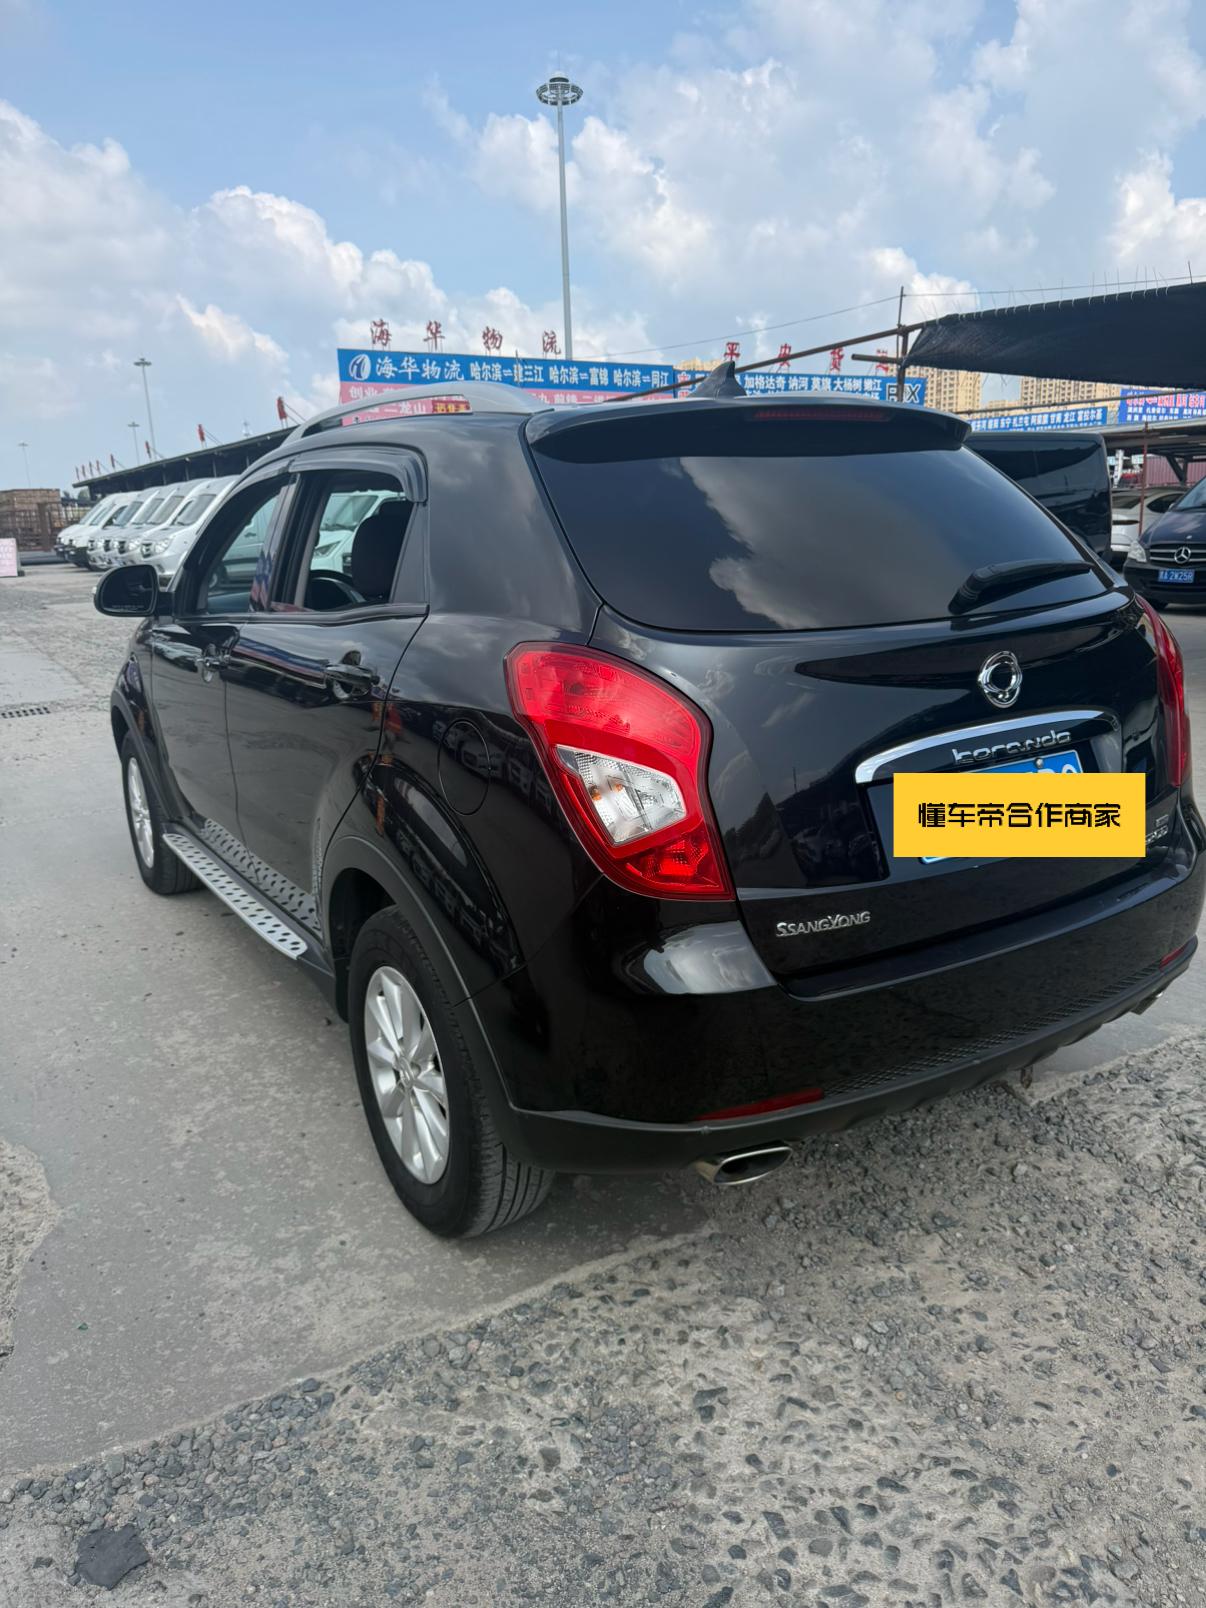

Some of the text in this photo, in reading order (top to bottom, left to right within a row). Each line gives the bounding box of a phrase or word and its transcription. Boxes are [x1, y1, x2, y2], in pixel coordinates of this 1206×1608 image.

[370, 318, 562, 355] 海华物流
[375, 356, 465, 381] 海华物流
[470, 361, 502, 381] 哈尔滨
[549, 364, 579, 385] 哈尔滨
[613, 367, 641, 388] 哈尔滨
[744, 374, 785, 391] 加格达奇
[952, 729, 1071, 765] korando
